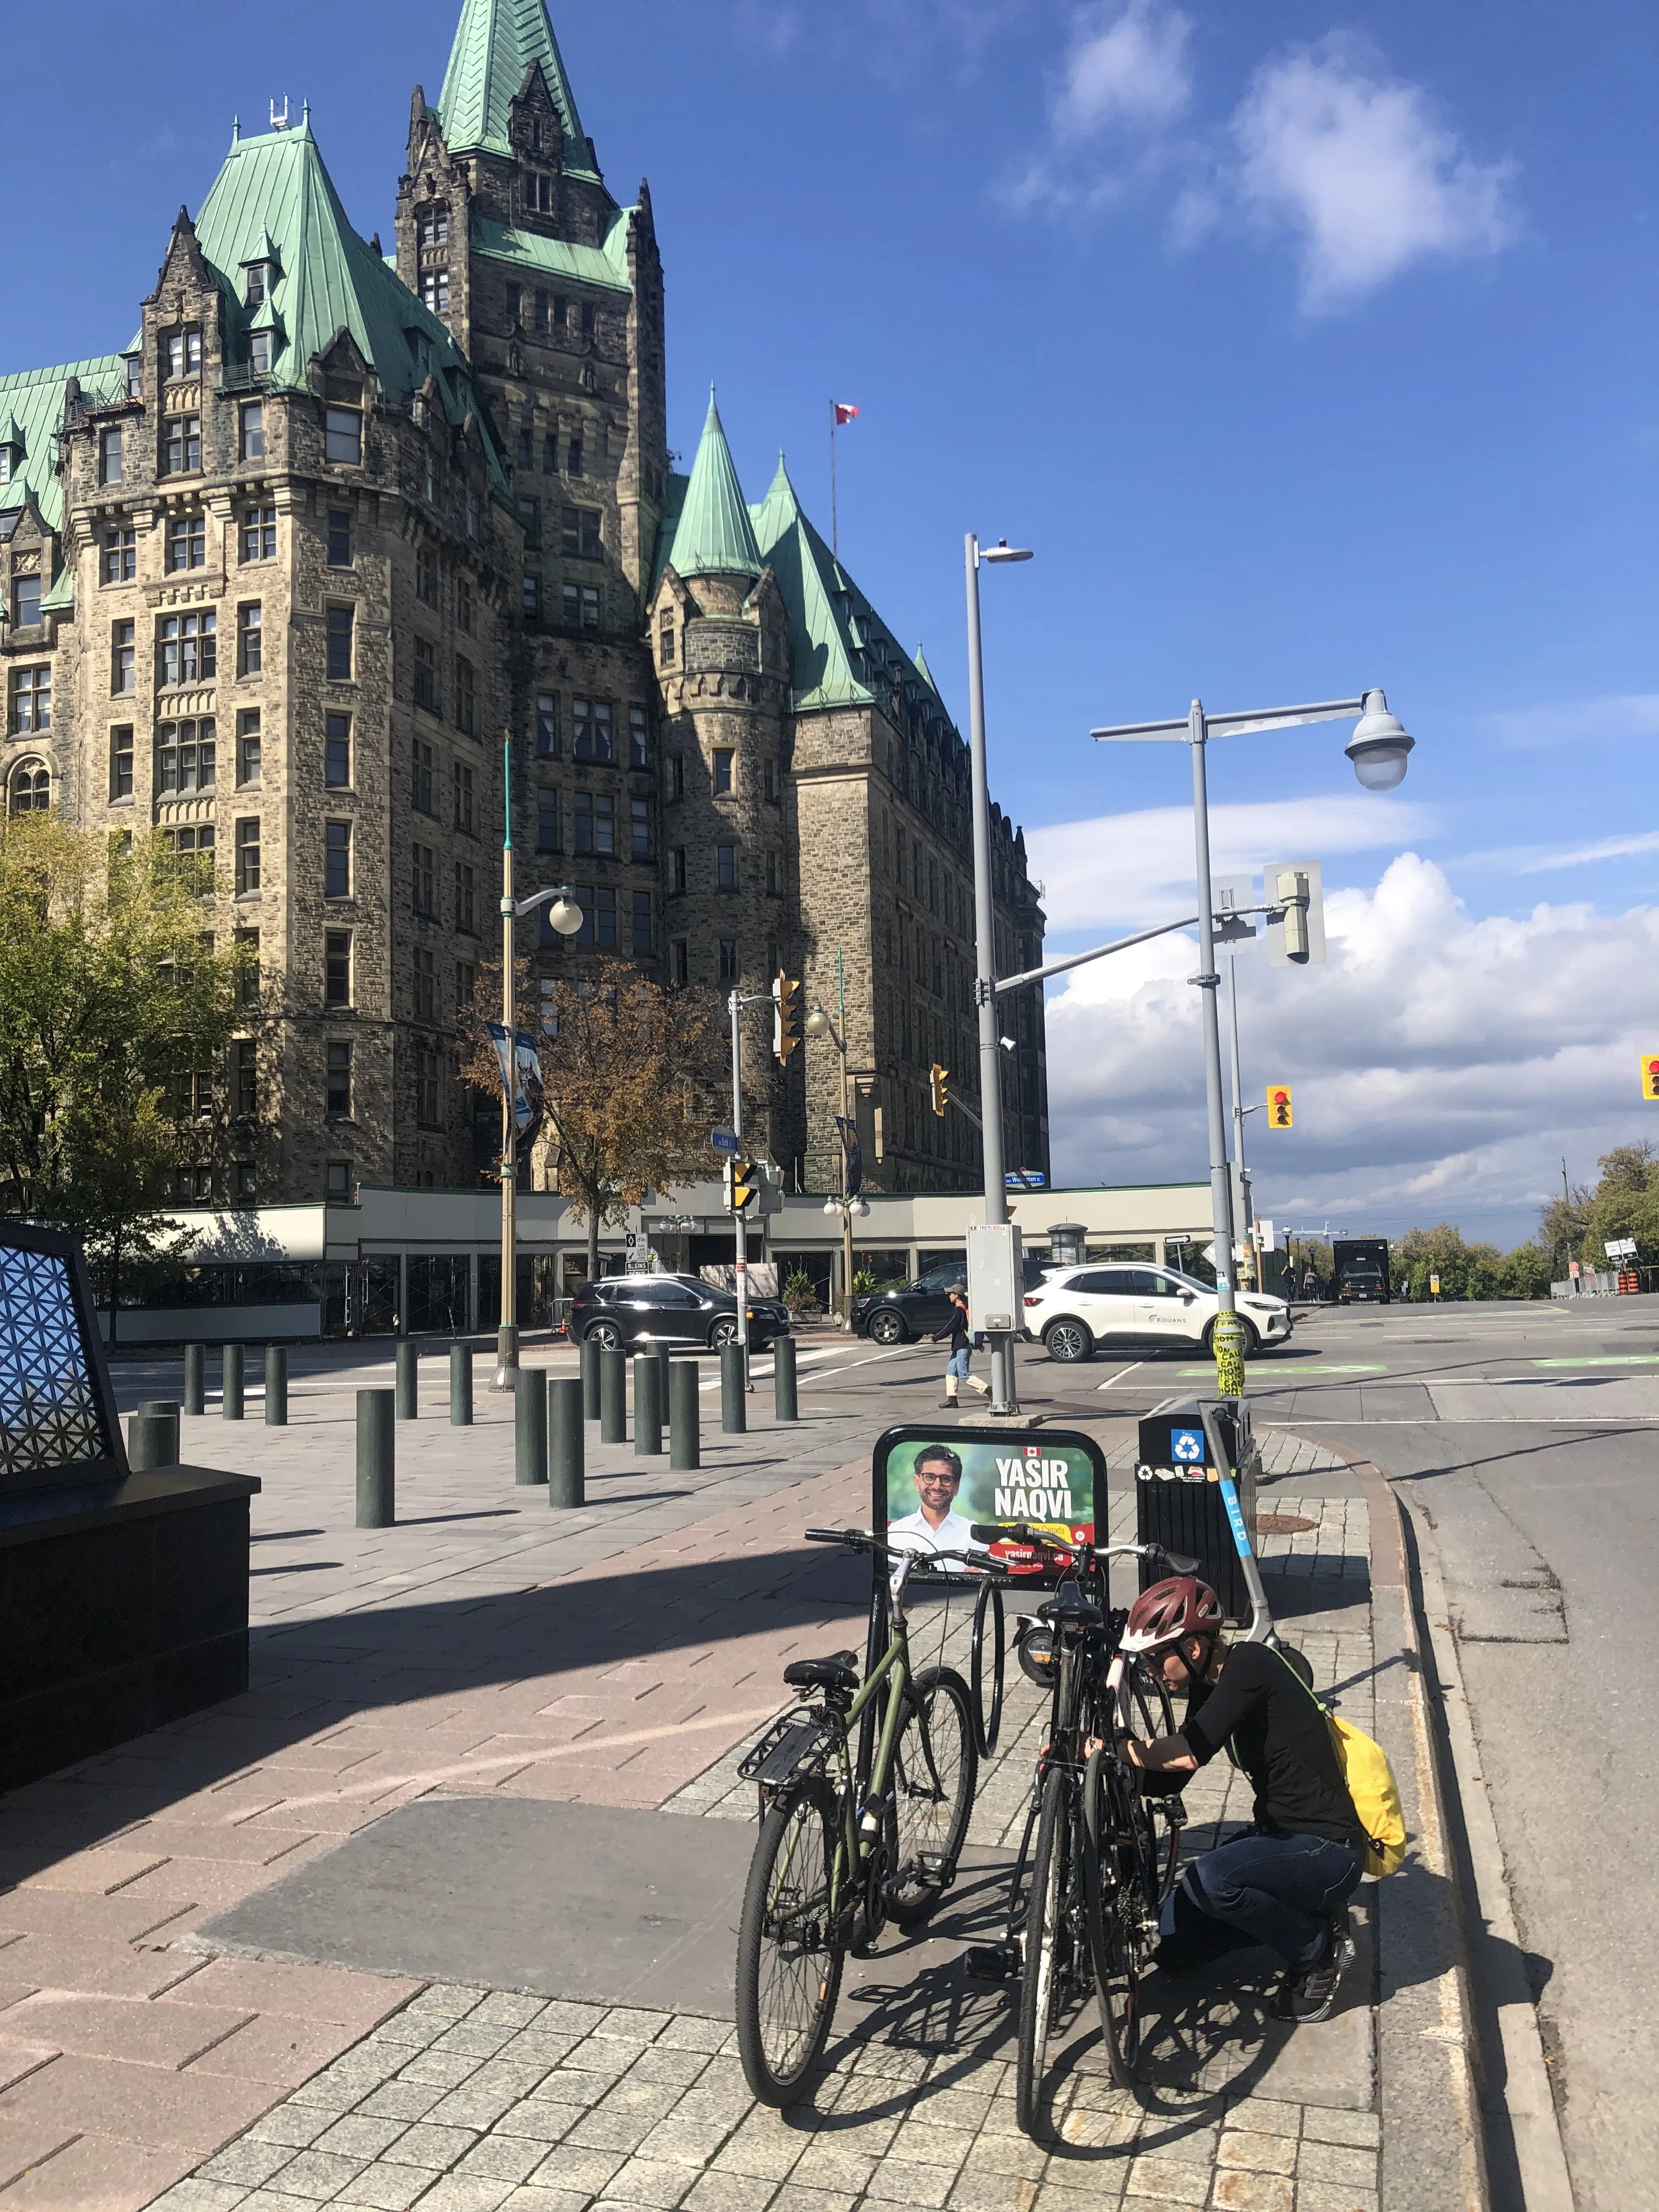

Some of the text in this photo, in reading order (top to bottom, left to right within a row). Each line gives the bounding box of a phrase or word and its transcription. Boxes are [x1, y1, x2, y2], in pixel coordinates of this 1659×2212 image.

[995, 1458, 1069, 1488] YASIR
[995, 1488, 1072, 1523] NAQVI
[1227, 1495, 1246, 1541] BIRD
[1005, 1548, 1064, 1562] yasirnaqvi.ca
